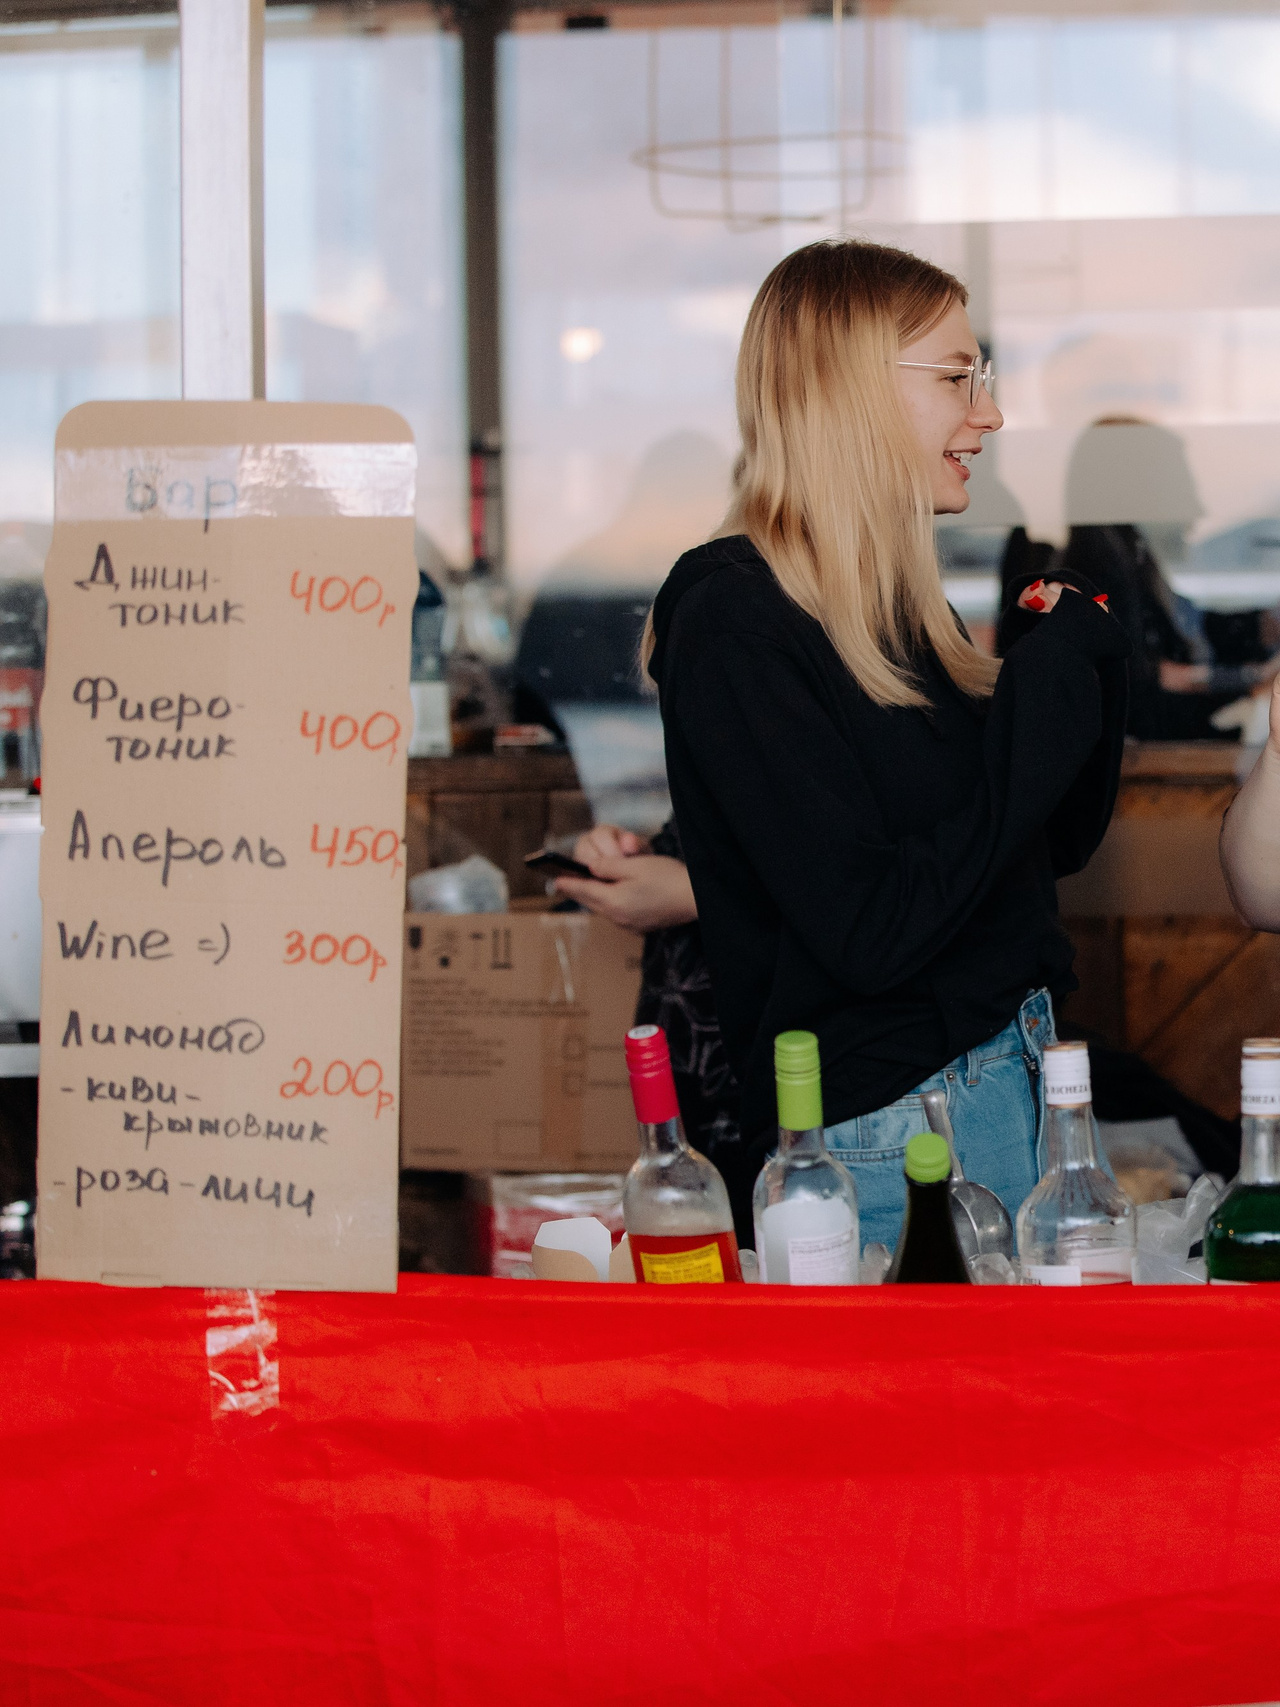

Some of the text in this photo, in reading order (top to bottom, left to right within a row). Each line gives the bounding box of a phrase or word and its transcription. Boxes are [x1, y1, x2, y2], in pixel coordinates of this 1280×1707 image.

[109, 599, 243, 628] тоник
[289, 570, 396, 628] 400р
[106, 734, 234, 763] тоник
[68, 809, 286, 888] Апероль
[57, 920, 173, 961] Wine
[61, 1010, 265, 1054] Лимонад
